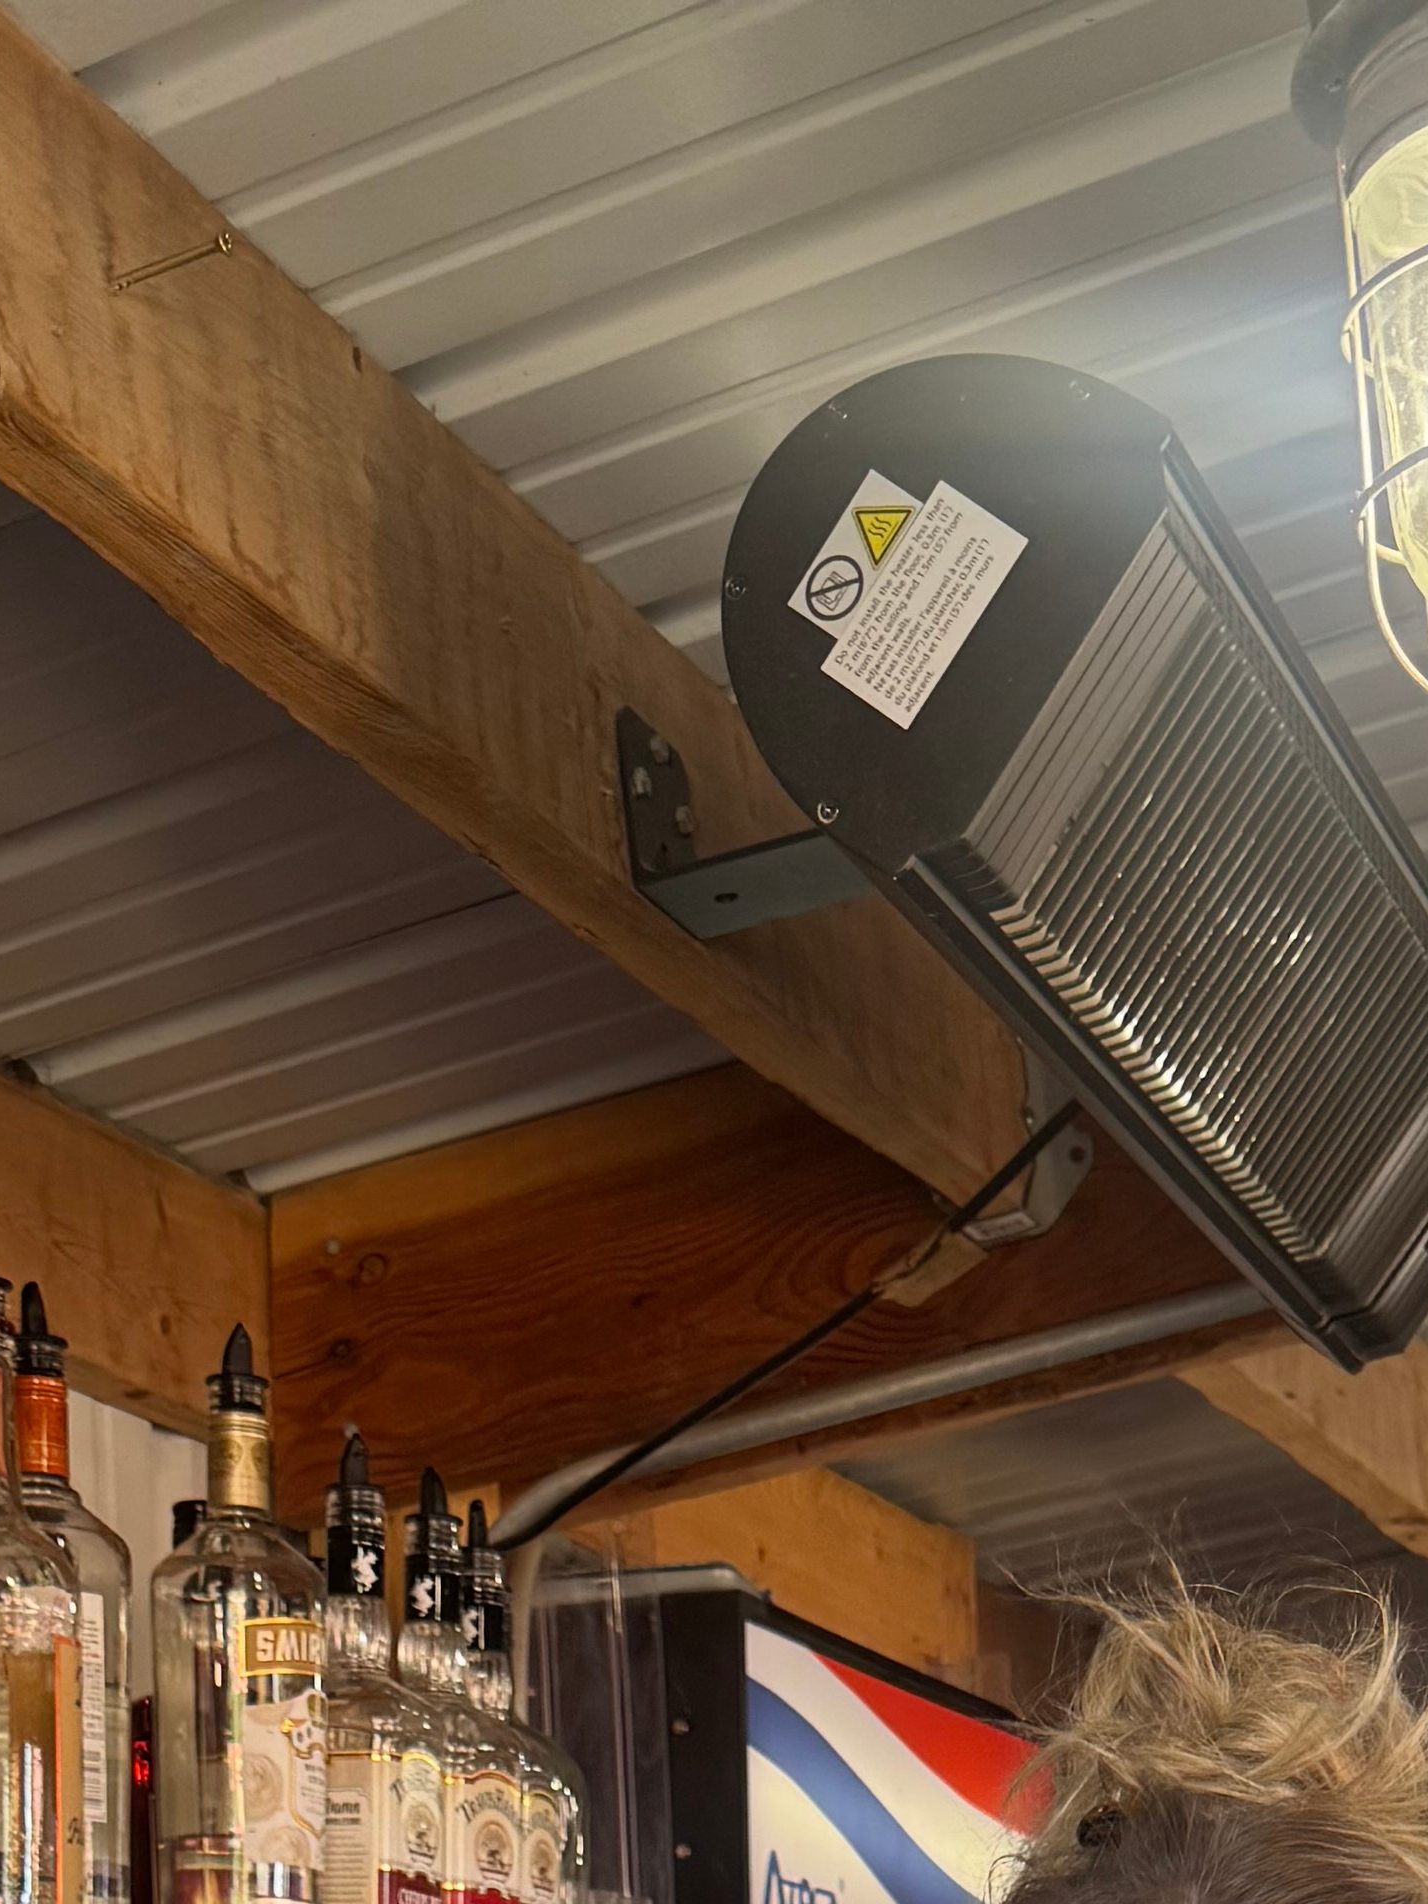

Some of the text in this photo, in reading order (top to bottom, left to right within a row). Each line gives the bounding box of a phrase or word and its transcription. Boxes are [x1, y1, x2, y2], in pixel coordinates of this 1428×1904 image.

[844, 628, 861, 648] not
[857, 596, 881, 627] install
[877, 577, 893, 596] the
[925, 496, 944, 521] than
[853, 652, 874, 678] from
[870, 633, 886, 652] the
[902, 578, 920, 601] and
[943, 510, 964, 537] from
[874, 598, 894, 624] from
[890, 578, 906, 597] the
[863, 642, 894, 685] adjacent
[882, 683, 897, 699] de
[920, 623, 935, 640] du
[882, 657, 899, 677] pas
[892, 690, 906, 706] du
[902, 652, 931, 691] plafond
[926, 641, 938, 653] et
[959, 582, 975, 602] des
[972, 553, 994, 580] murs
